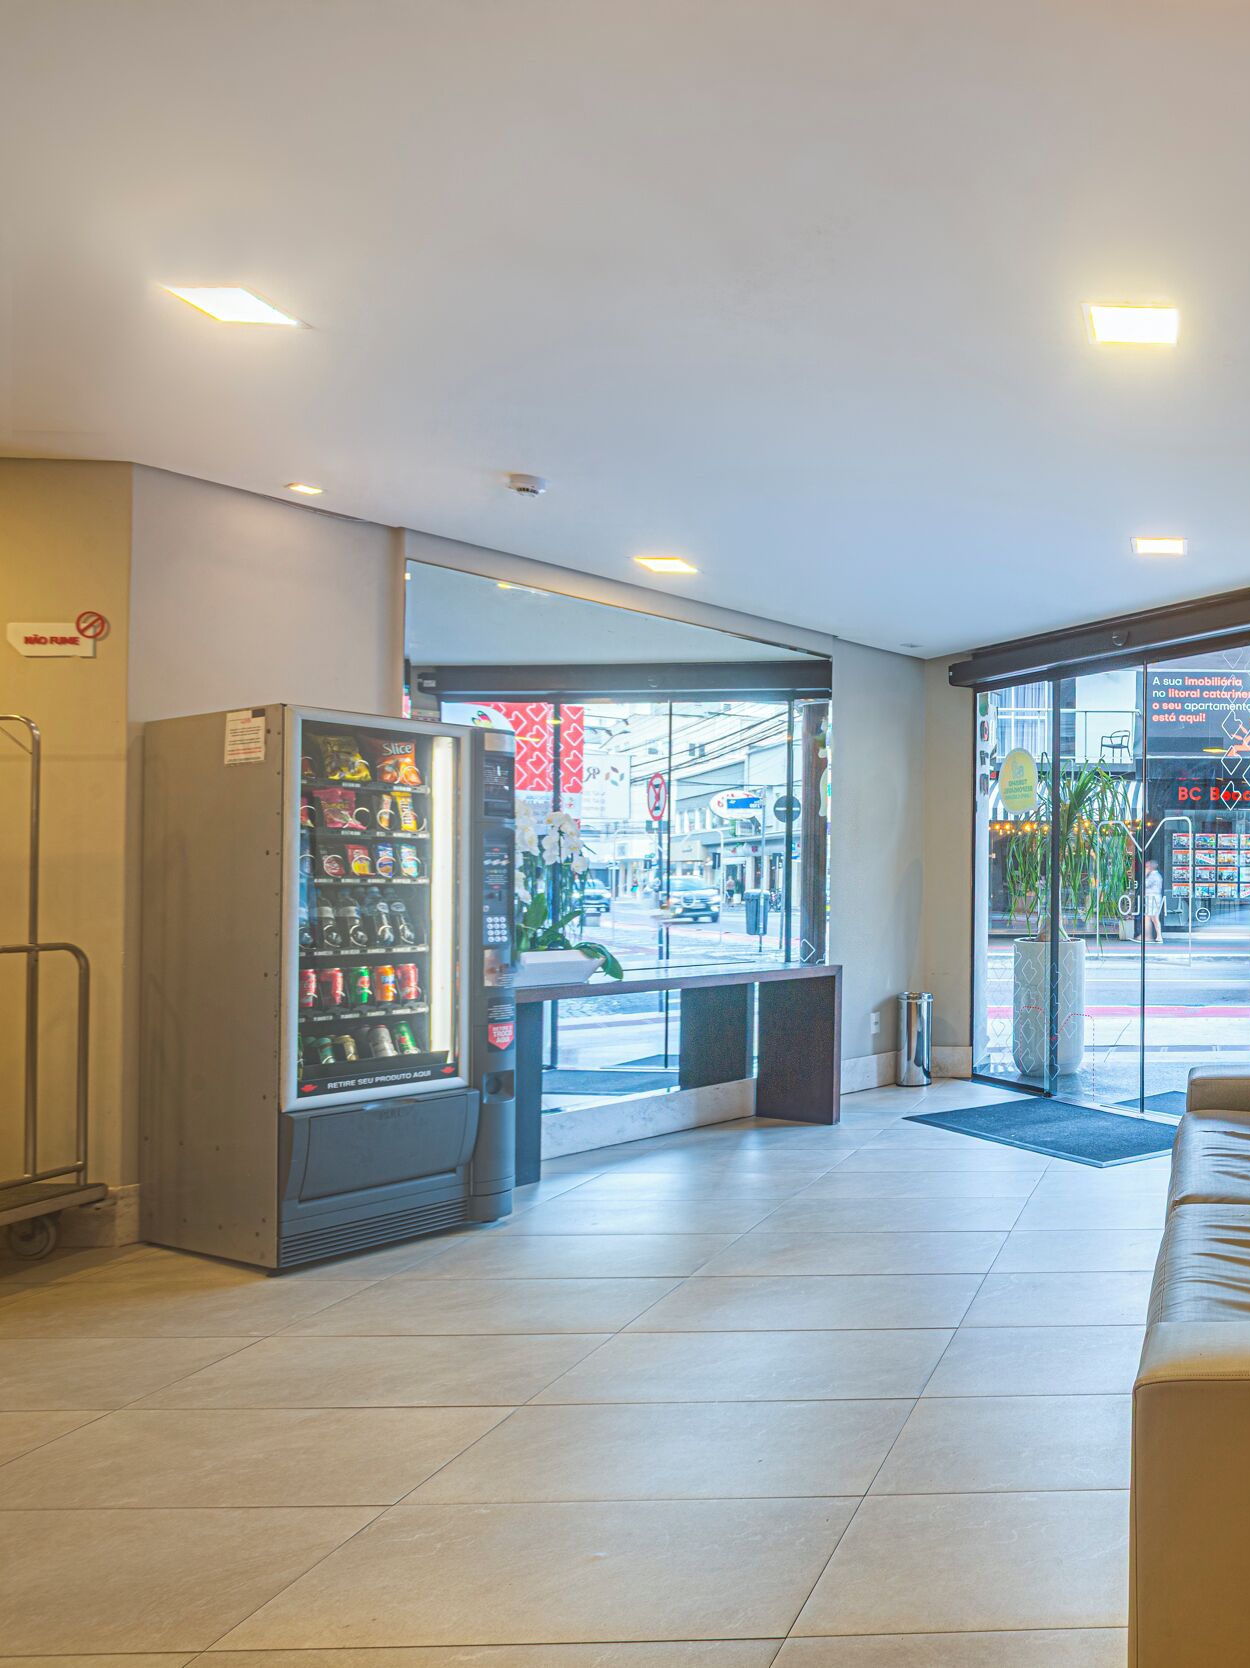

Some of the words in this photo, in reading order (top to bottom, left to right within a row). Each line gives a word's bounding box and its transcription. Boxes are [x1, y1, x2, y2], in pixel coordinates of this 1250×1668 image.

[24, 634, 48, 645] NÃO
[49, 636, 80, 646] FUME
[1152, 676, 1161, 686] A
[1163, 678, 1182, 686] sua
[1184, 676, 1243, 686] imobiliária
[1152, 690, 1166, 698] no
[1168, 688, 1200, 698] litoral
[1152, 702, 1160, 710] o
[1162, 702, 1182, 710] seu
[1152, 713, 1176, 722] está
[1178, 713, 1206, 724] aqui!
[382, 743, 412, 756] Slice
[1178, 787, 1202, 801] BC
[328, 1079, 356, 1089] RETIRE
[357, 1077, 374, 1085] SEU
[375, 1073, 412, 1083] PRODUTO
[413, 1070, 432, 1078] AQUI
